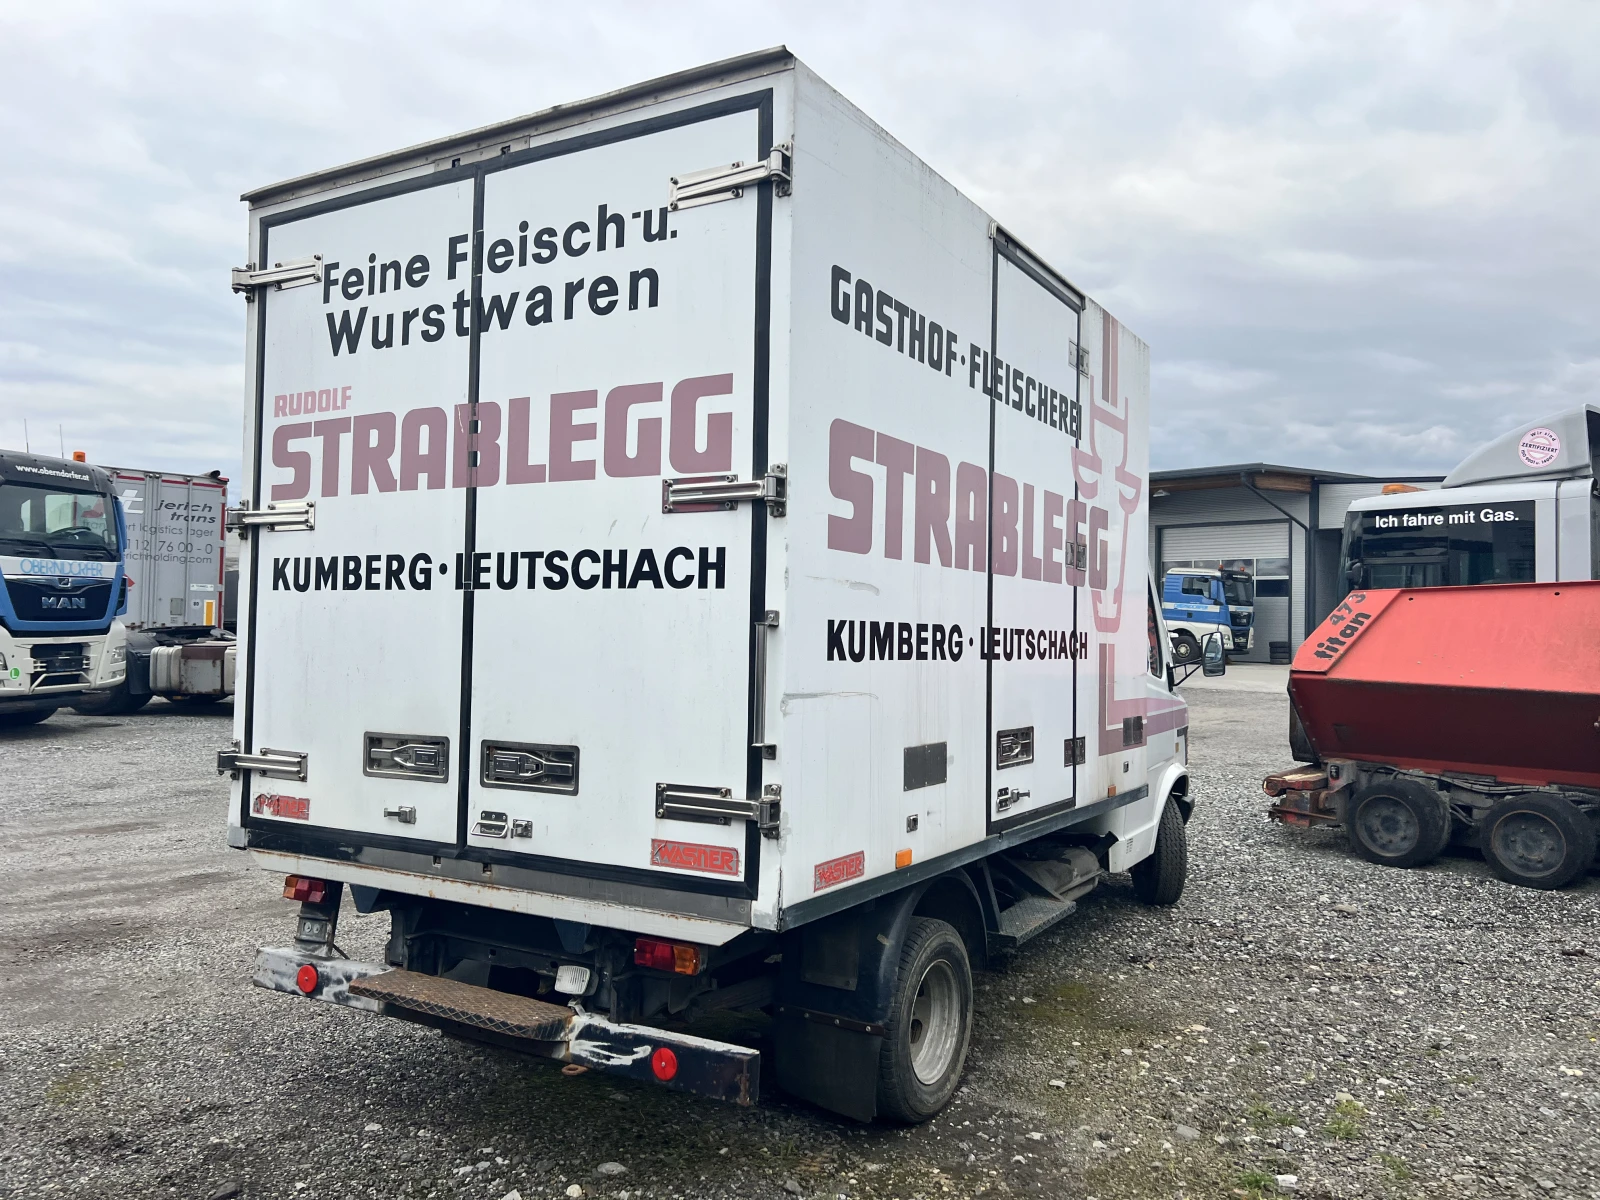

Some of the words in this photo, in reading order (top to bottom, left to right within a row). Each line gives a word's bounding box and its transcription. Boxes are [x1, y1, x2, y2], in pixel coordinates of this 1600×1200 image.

[323, 254, 430, 304] Feine
[326, 266, 660, 357] Wurstwaren
[274, 386, 352, 418] RUDOLF
[270, 373, 734, 501] STRABLEGG
[15, 464, 90, 482] www.oberndorfer.at
[154, 500, 212, 512] jerich
[170, 511, 217, 524] trans
[827, 418, 1109, 591] STRABLEGG
[1375, 515, 1398, 528] Ich
[1402, 513, 1444, 527] fahre
[1448, 510, 1475, 525] mit
[1480, 508, 1519, 522] Gas.
[20, 558, 104, 576] OBERNDORFER
[41, 596, 86, 609] MAN
[1329, 592, 1367, 626] 473
[1313, 612, 1372, 660] titan
